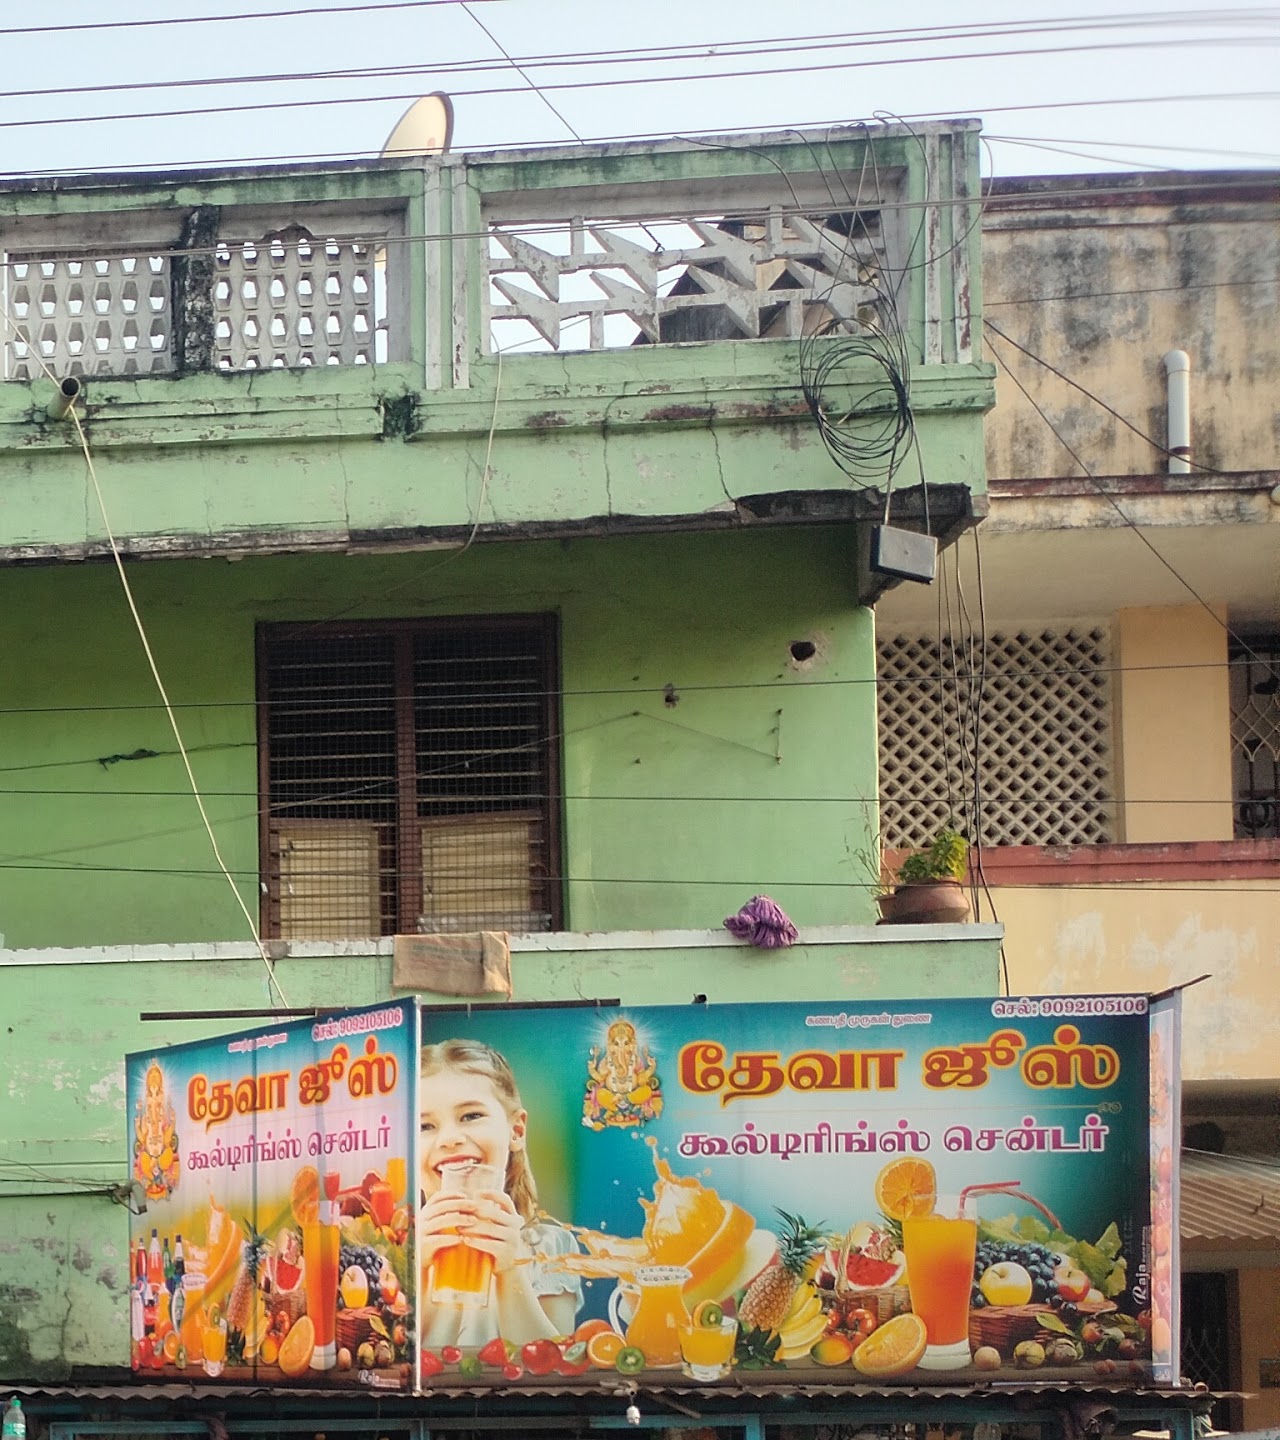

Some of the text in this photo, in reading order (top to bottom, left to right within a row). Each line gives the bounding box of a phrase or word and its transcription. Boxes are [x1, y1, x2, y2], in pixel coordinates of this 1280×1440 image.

[1040, 998, 1147, 1017] 9092105106
[187, 1035, 399, 1134] தேவா ஜூஸ்
[678, 1023, 1122, 1109] தேவா ஜூஸ்
[308, 1115, 391, 1157] சென்டர்
[943, 1113, 1109, 1155] சென்டர்
